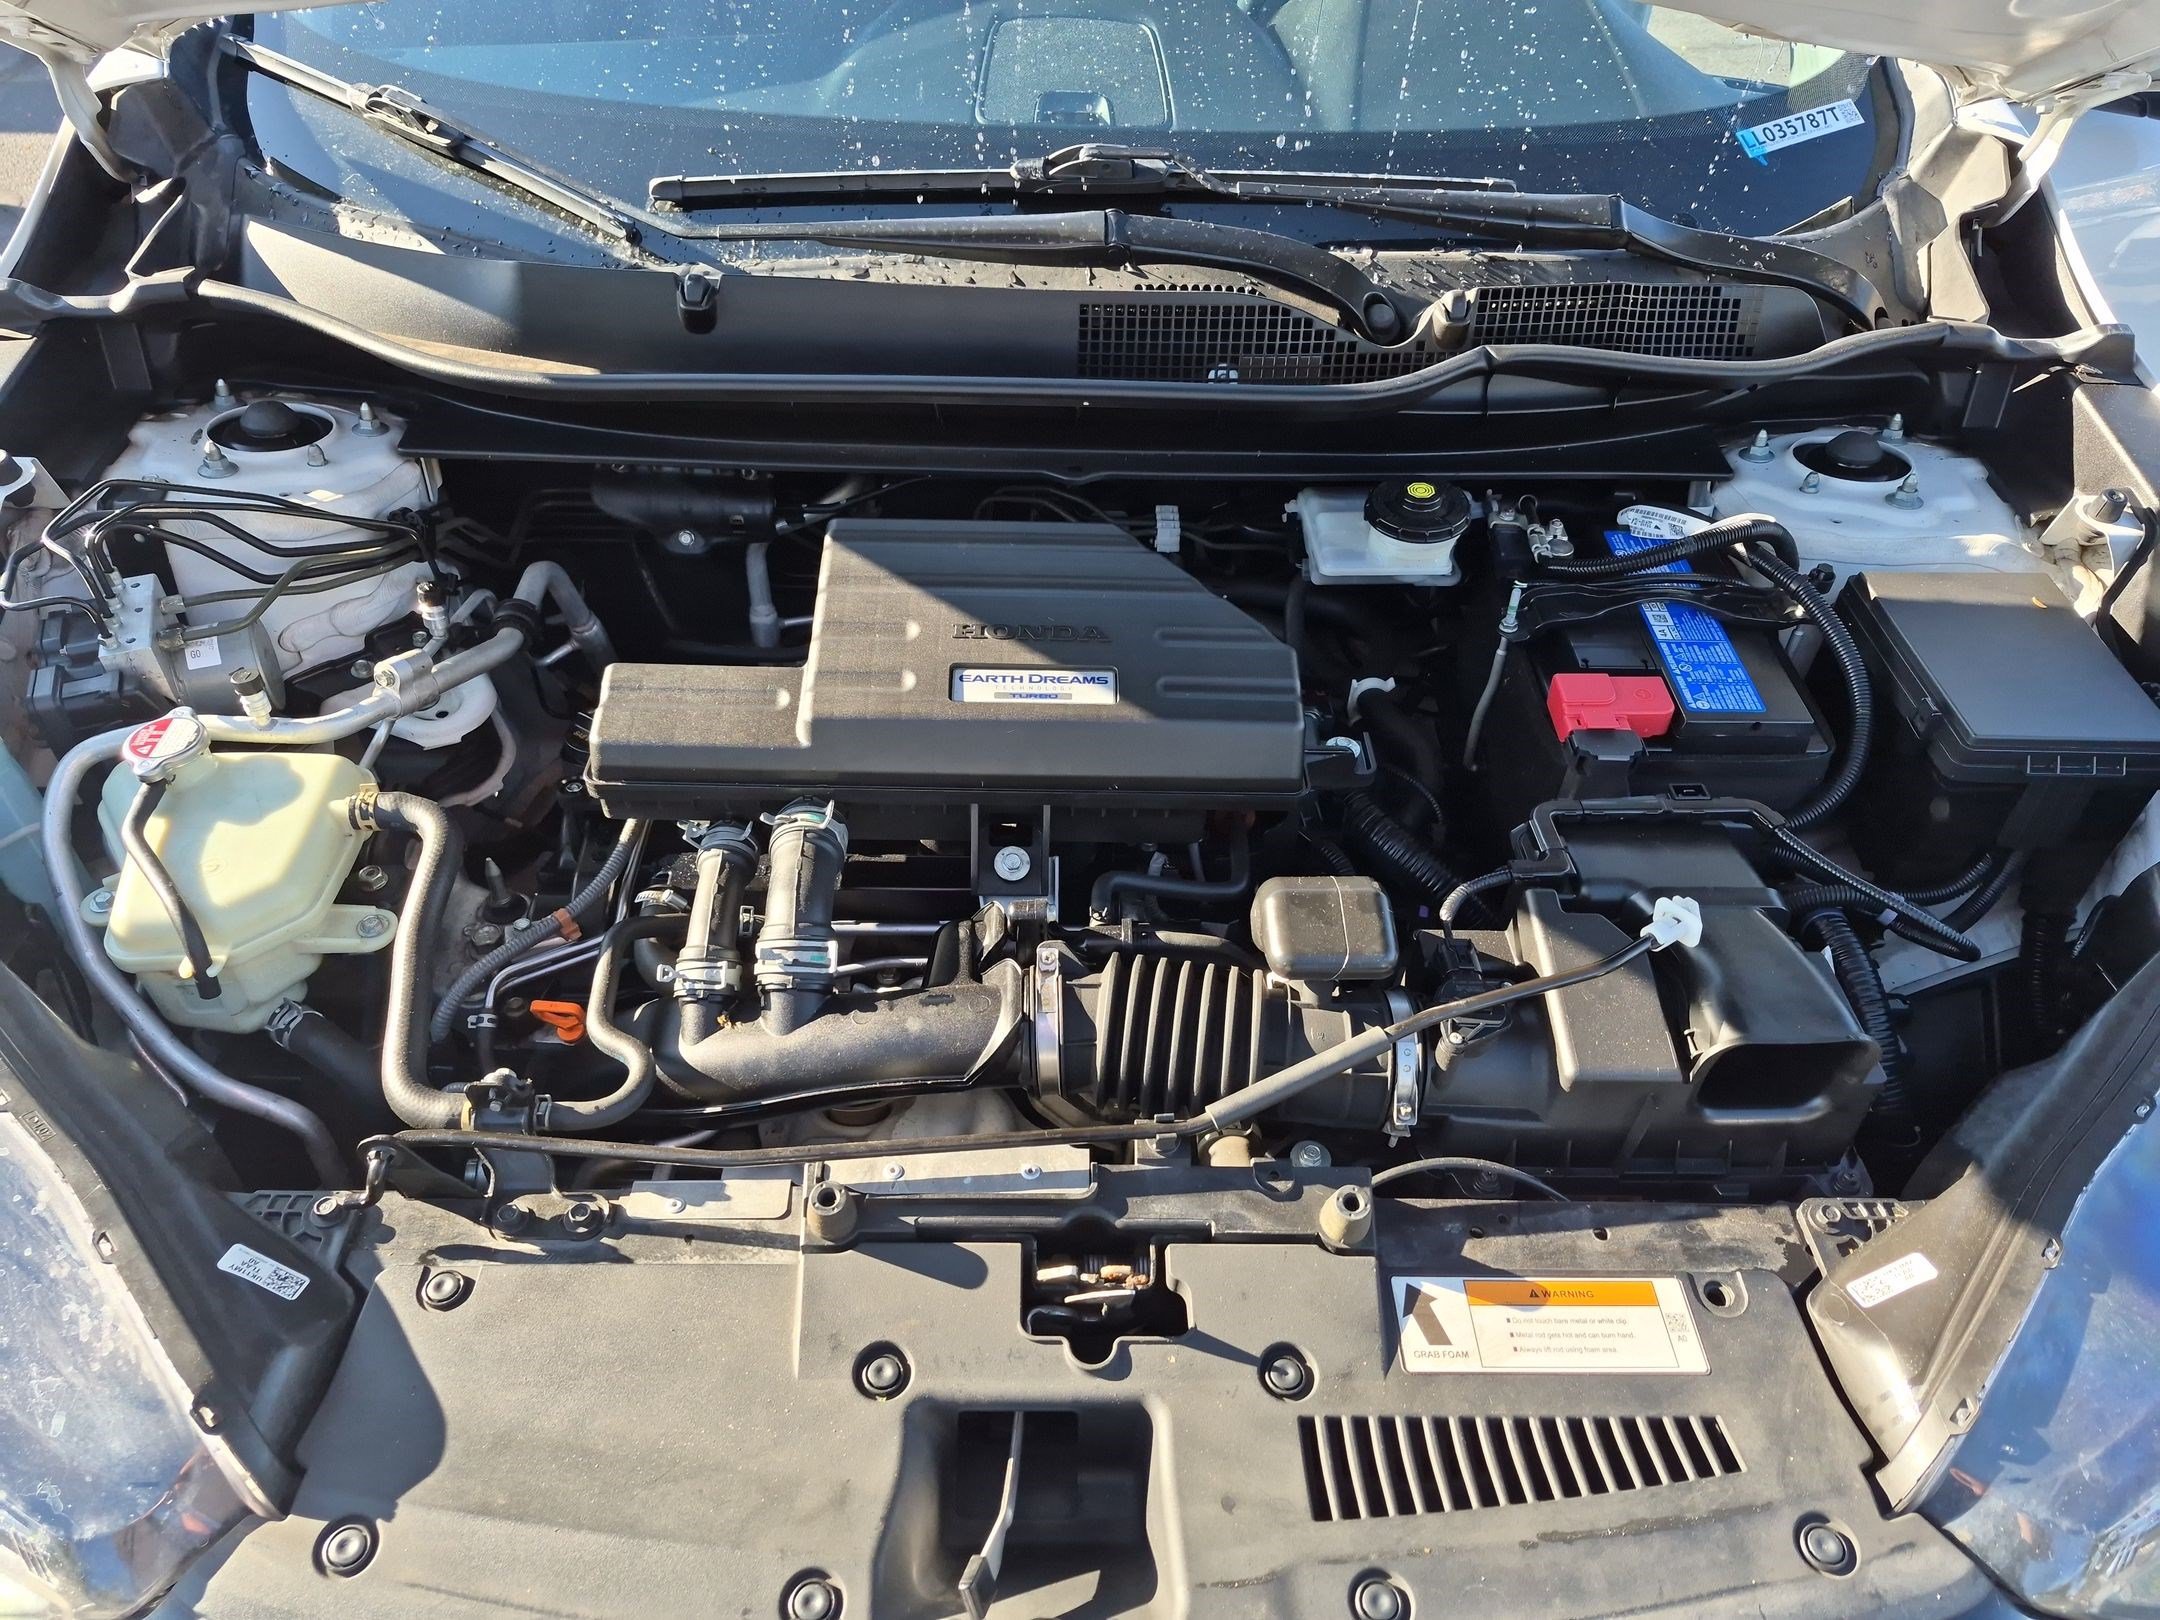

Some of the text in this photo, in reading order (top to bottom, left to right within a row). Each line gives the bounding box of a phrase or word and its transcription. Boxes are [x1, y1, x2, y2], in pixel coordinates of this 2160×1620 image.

[1740, 106, 1840, 149] LL035787T
[951, 623, 1112, 642] HONDA
[959, 674, 1108, 685] EARTH DREAMS
[1541, 1289, 1594, 1298] WARNING
[1413, 1350, 1470, 1359] GRAB FOAM
